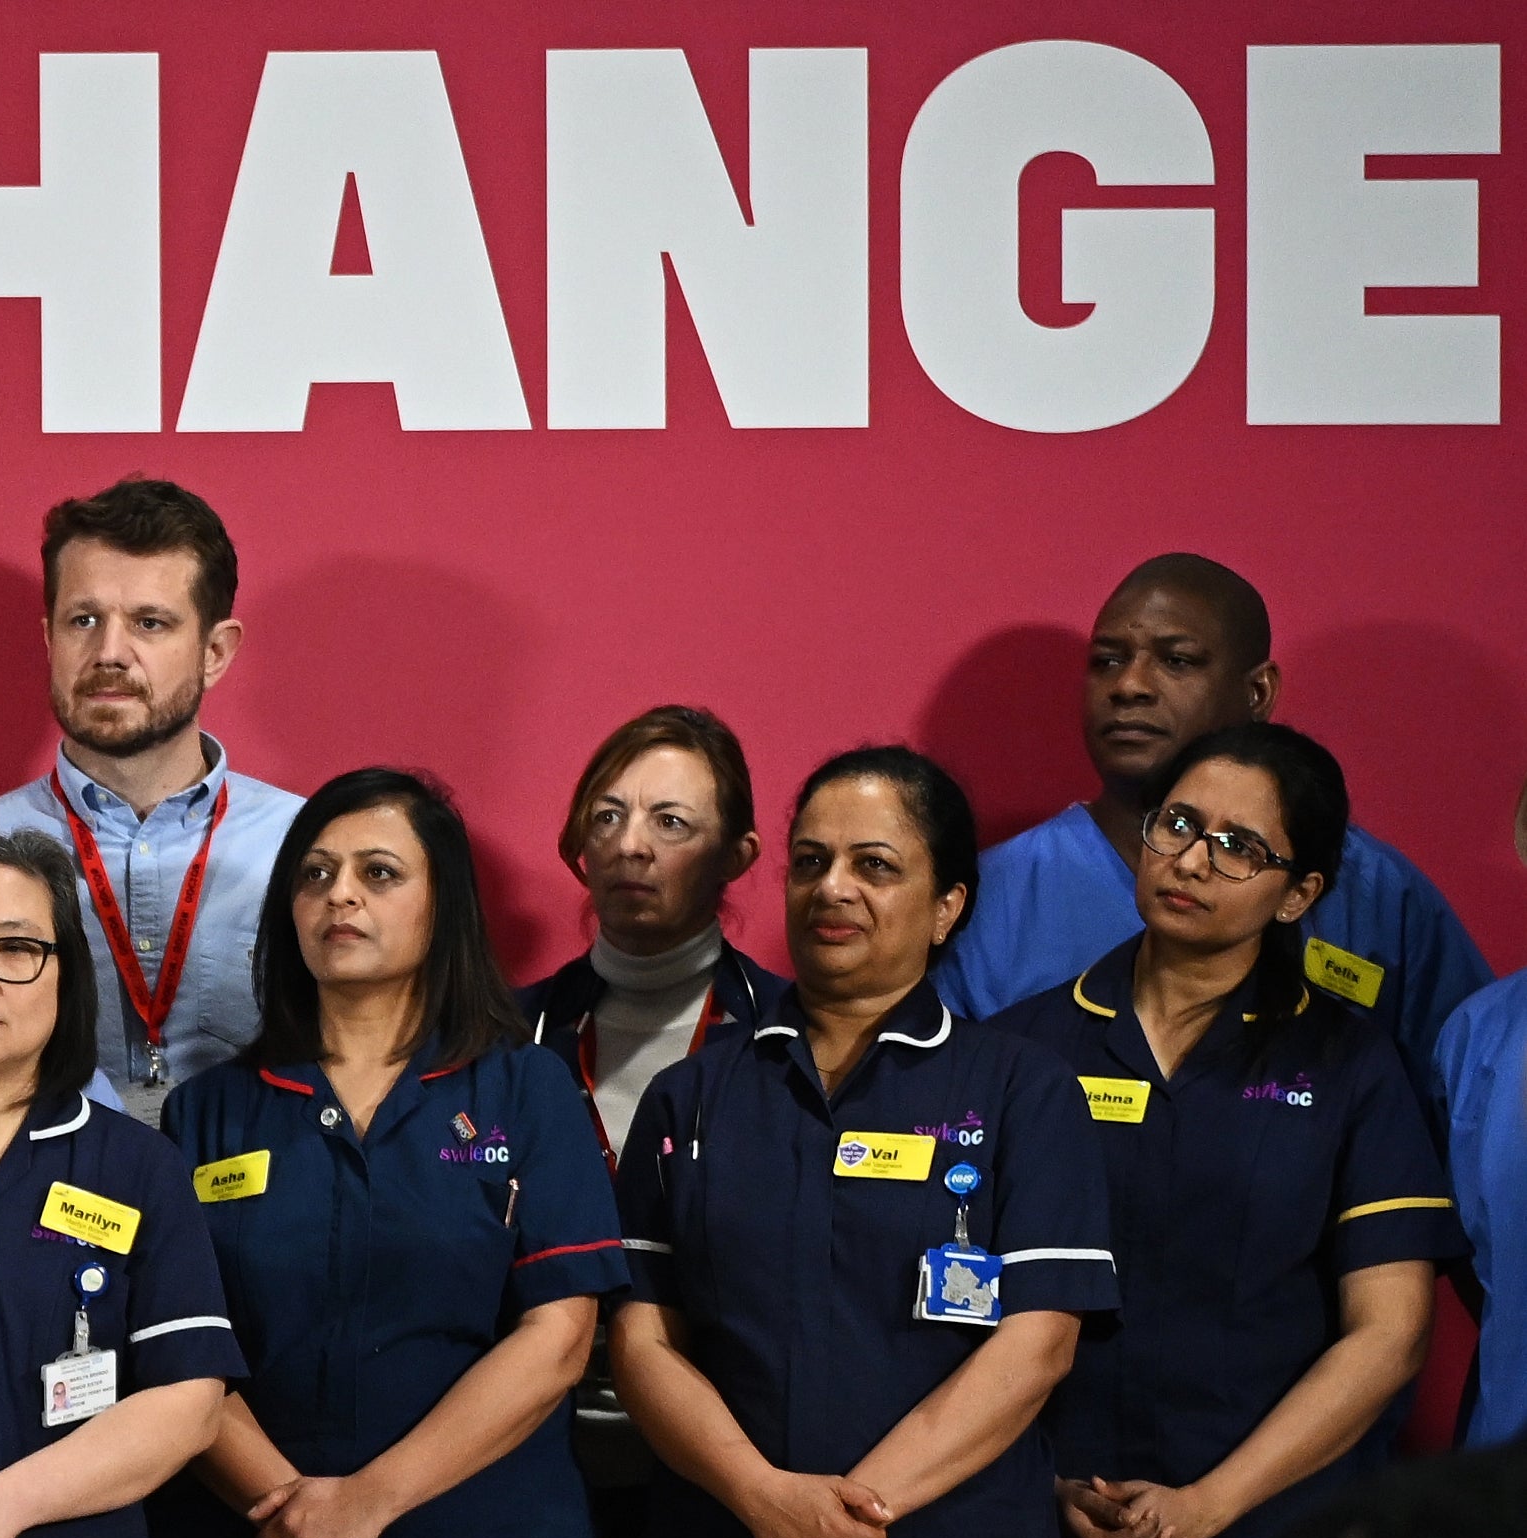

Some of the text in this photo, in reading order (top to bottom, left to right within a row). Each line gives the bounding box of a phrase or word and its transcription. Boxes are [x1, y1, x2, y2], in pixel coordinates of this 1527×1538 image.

[1325, 959, 1361, 984] Felix
[1087, 1091, 1134, 1105] ishna
[453, 1119, 472, 1139] NHS
[871, 1148, 899, 1161] Val
[210, 1171, 246, 1188] Asha
[951, 1173, 975, 1183] NHS
[60, 1202, 122, 1232] Marilyn
